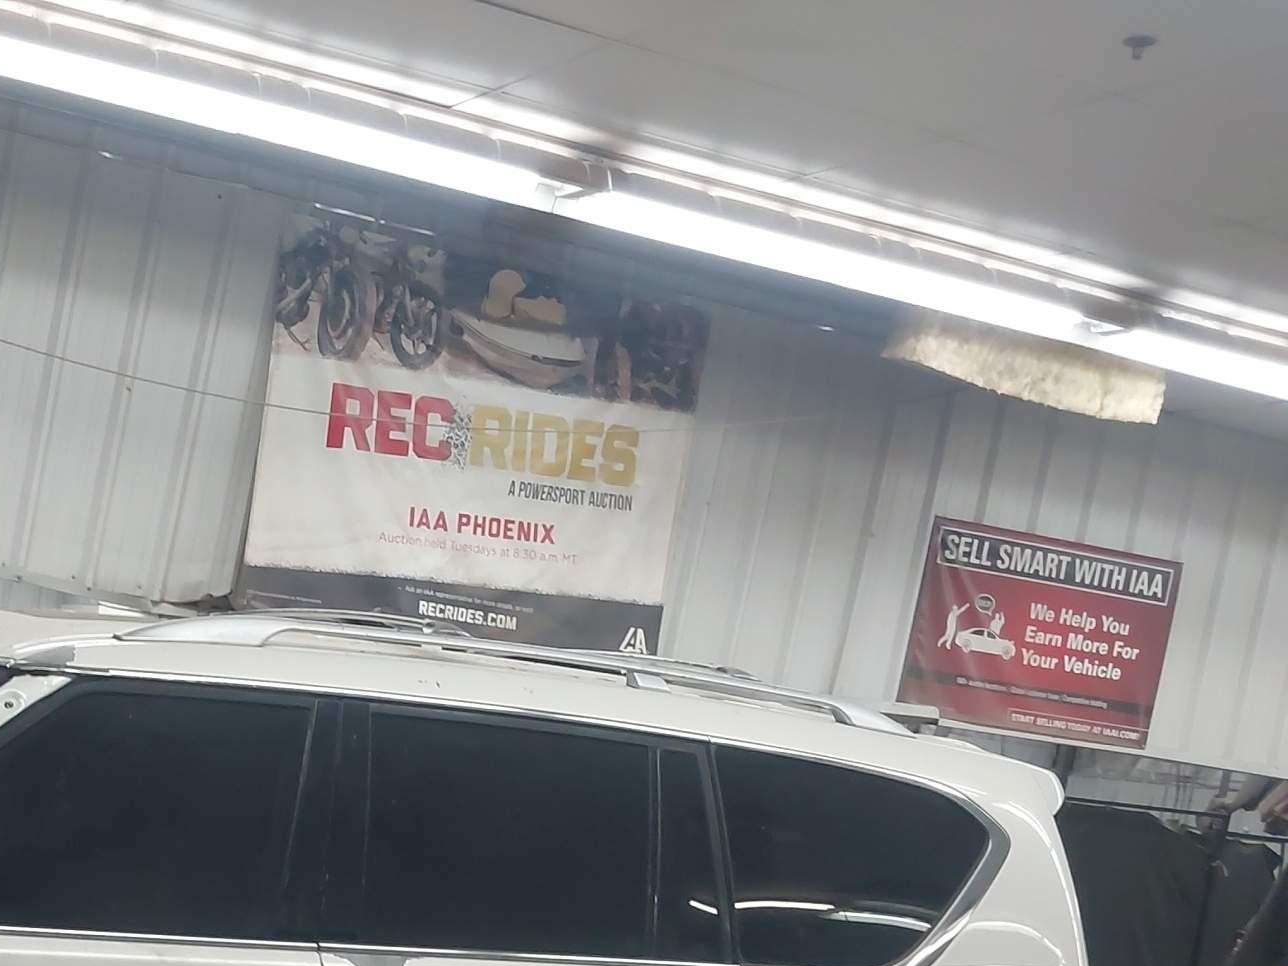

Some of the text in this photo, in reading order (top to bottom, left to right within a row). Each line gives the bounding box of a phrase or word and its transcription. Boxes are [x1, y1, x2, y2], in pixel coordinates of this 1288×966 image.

[326, 383, 640, 487] REC RIDES
[508, 480, 633, 511] A POWERSPORT AUCTION
[409, 506, 555, 544] IAA PHOENIX
[379, 532, 421, 546] Auction
[450, 540, 496, 557] Tuesdays
[500, 547, 510, 558] at
[943, 534, 1163, 598] SELL SMART WITH IAA
[418, 600, 517, 631] RECRIDES.COM
[1030, 603, 1130, 636] We Help You
[1025, 626, 1140, 661] Earn More For
[1021, 648, 1122, 681] Your Vehicle
[1011, 713, 1035, 725] START
[1035, 717, 1066, 730] SELLING
[1067, 721, 1092, 734] TODAY
